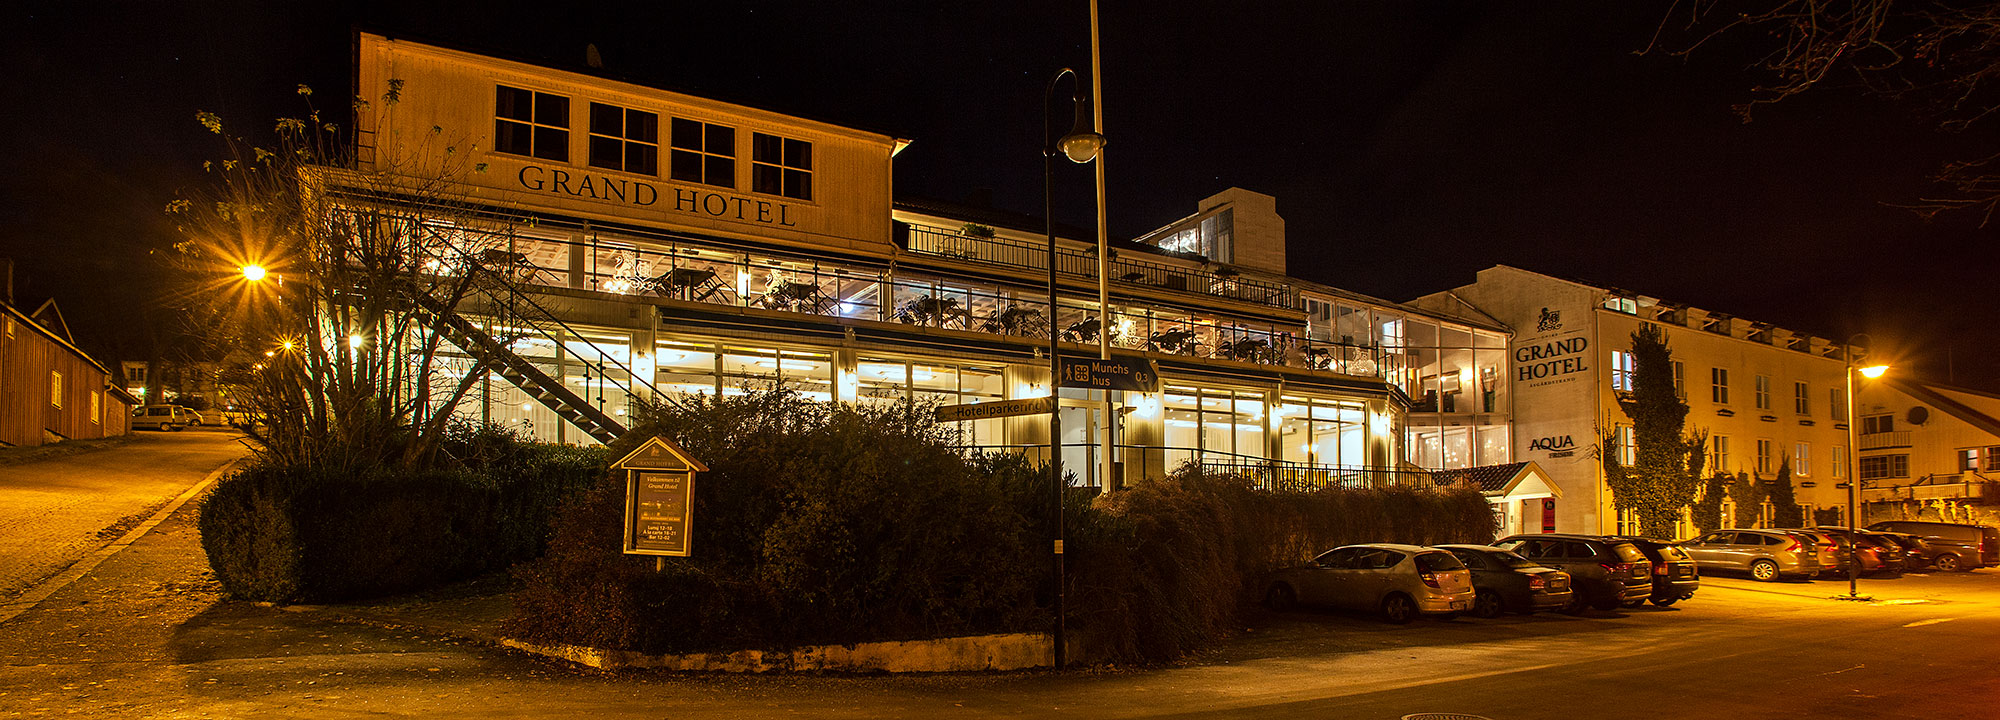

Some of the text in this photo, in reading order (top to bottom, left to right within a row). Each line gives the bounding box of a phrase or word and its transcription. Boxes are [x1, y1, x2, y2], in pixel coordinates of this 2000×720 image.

[518, 165, 796, 227] GRAND HOTEL
[1516, 337, 1588, 362] GRAND
[1092, 361, 1129, 375] Munchs
[1518, 356, 1588, 382] HOTEL
[1092, 374, 1111, 387] hus
[1135, 371, 1149, 383] 0,3
[956, 402, 1042, 418] Hotellparkering
[1529, 434, 1575, 451] AQUA
